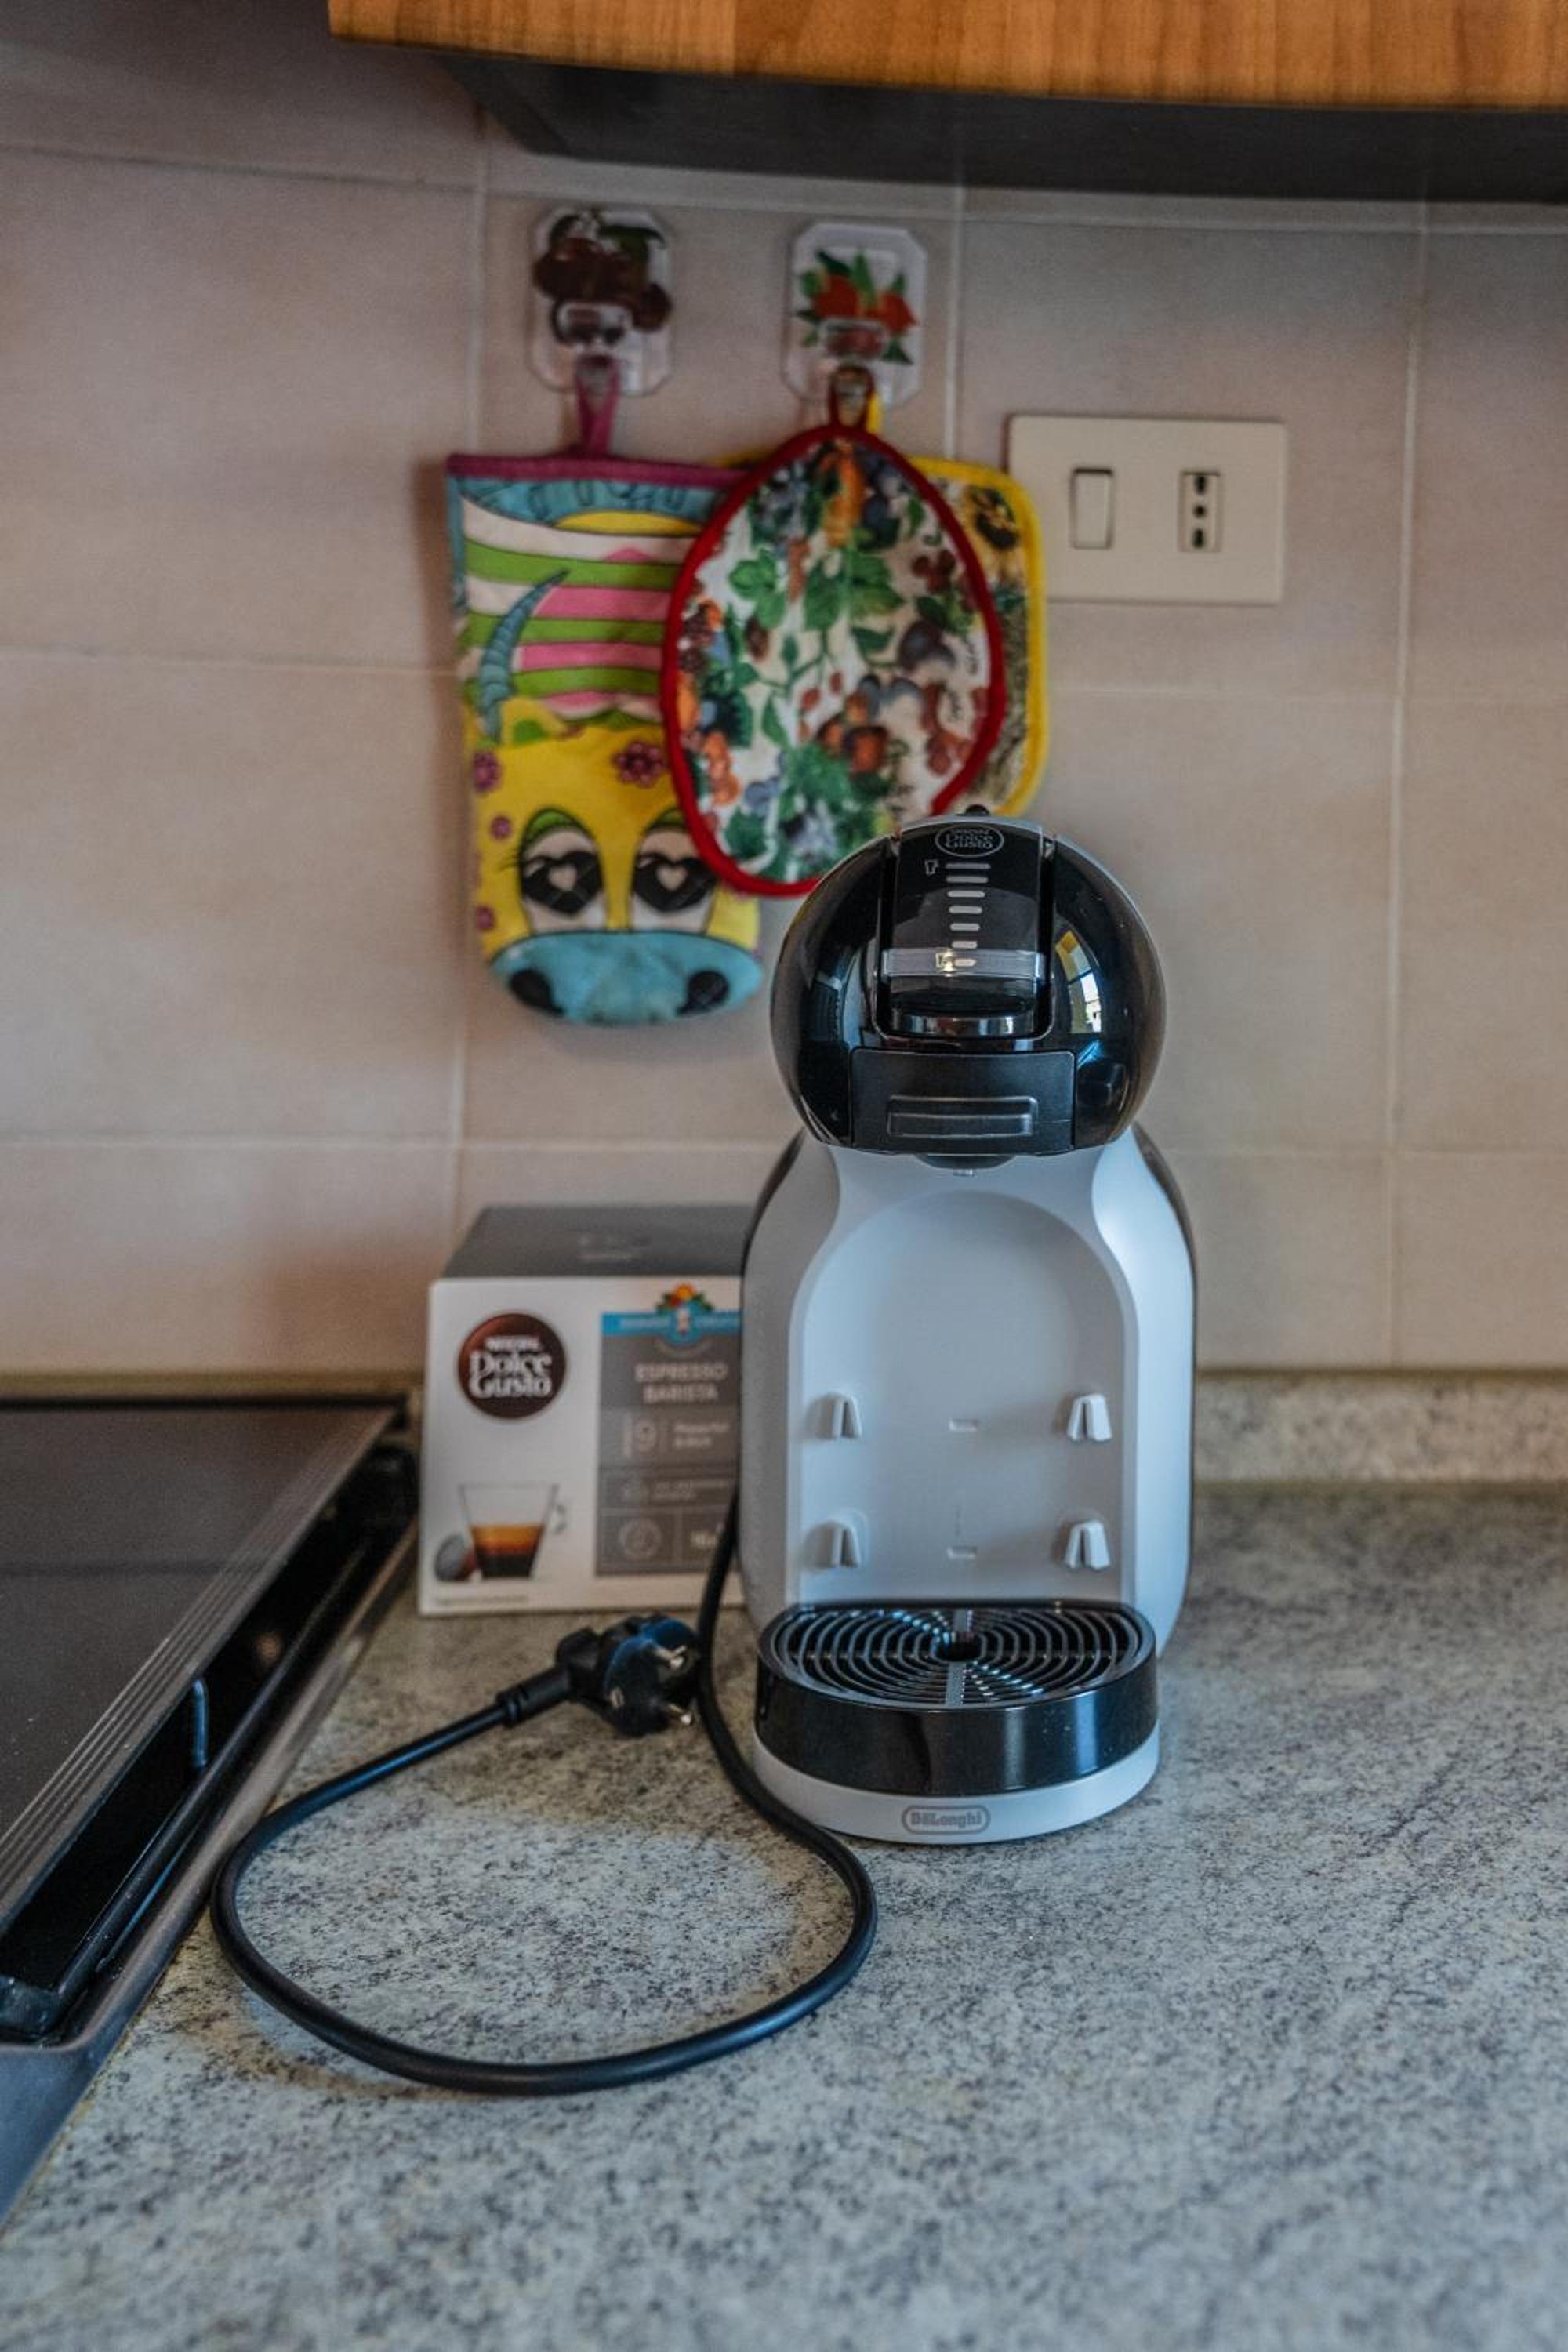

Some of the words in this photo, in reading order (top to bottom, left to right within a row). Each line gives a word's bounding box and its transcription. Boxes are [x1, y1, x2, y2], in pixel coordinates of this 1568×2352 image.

[470, 1352, 553, 1377] Dolce
[635, 1363, 728, 1382] ESPRESSO
[469, 1375, 553, 1399] Gusto
